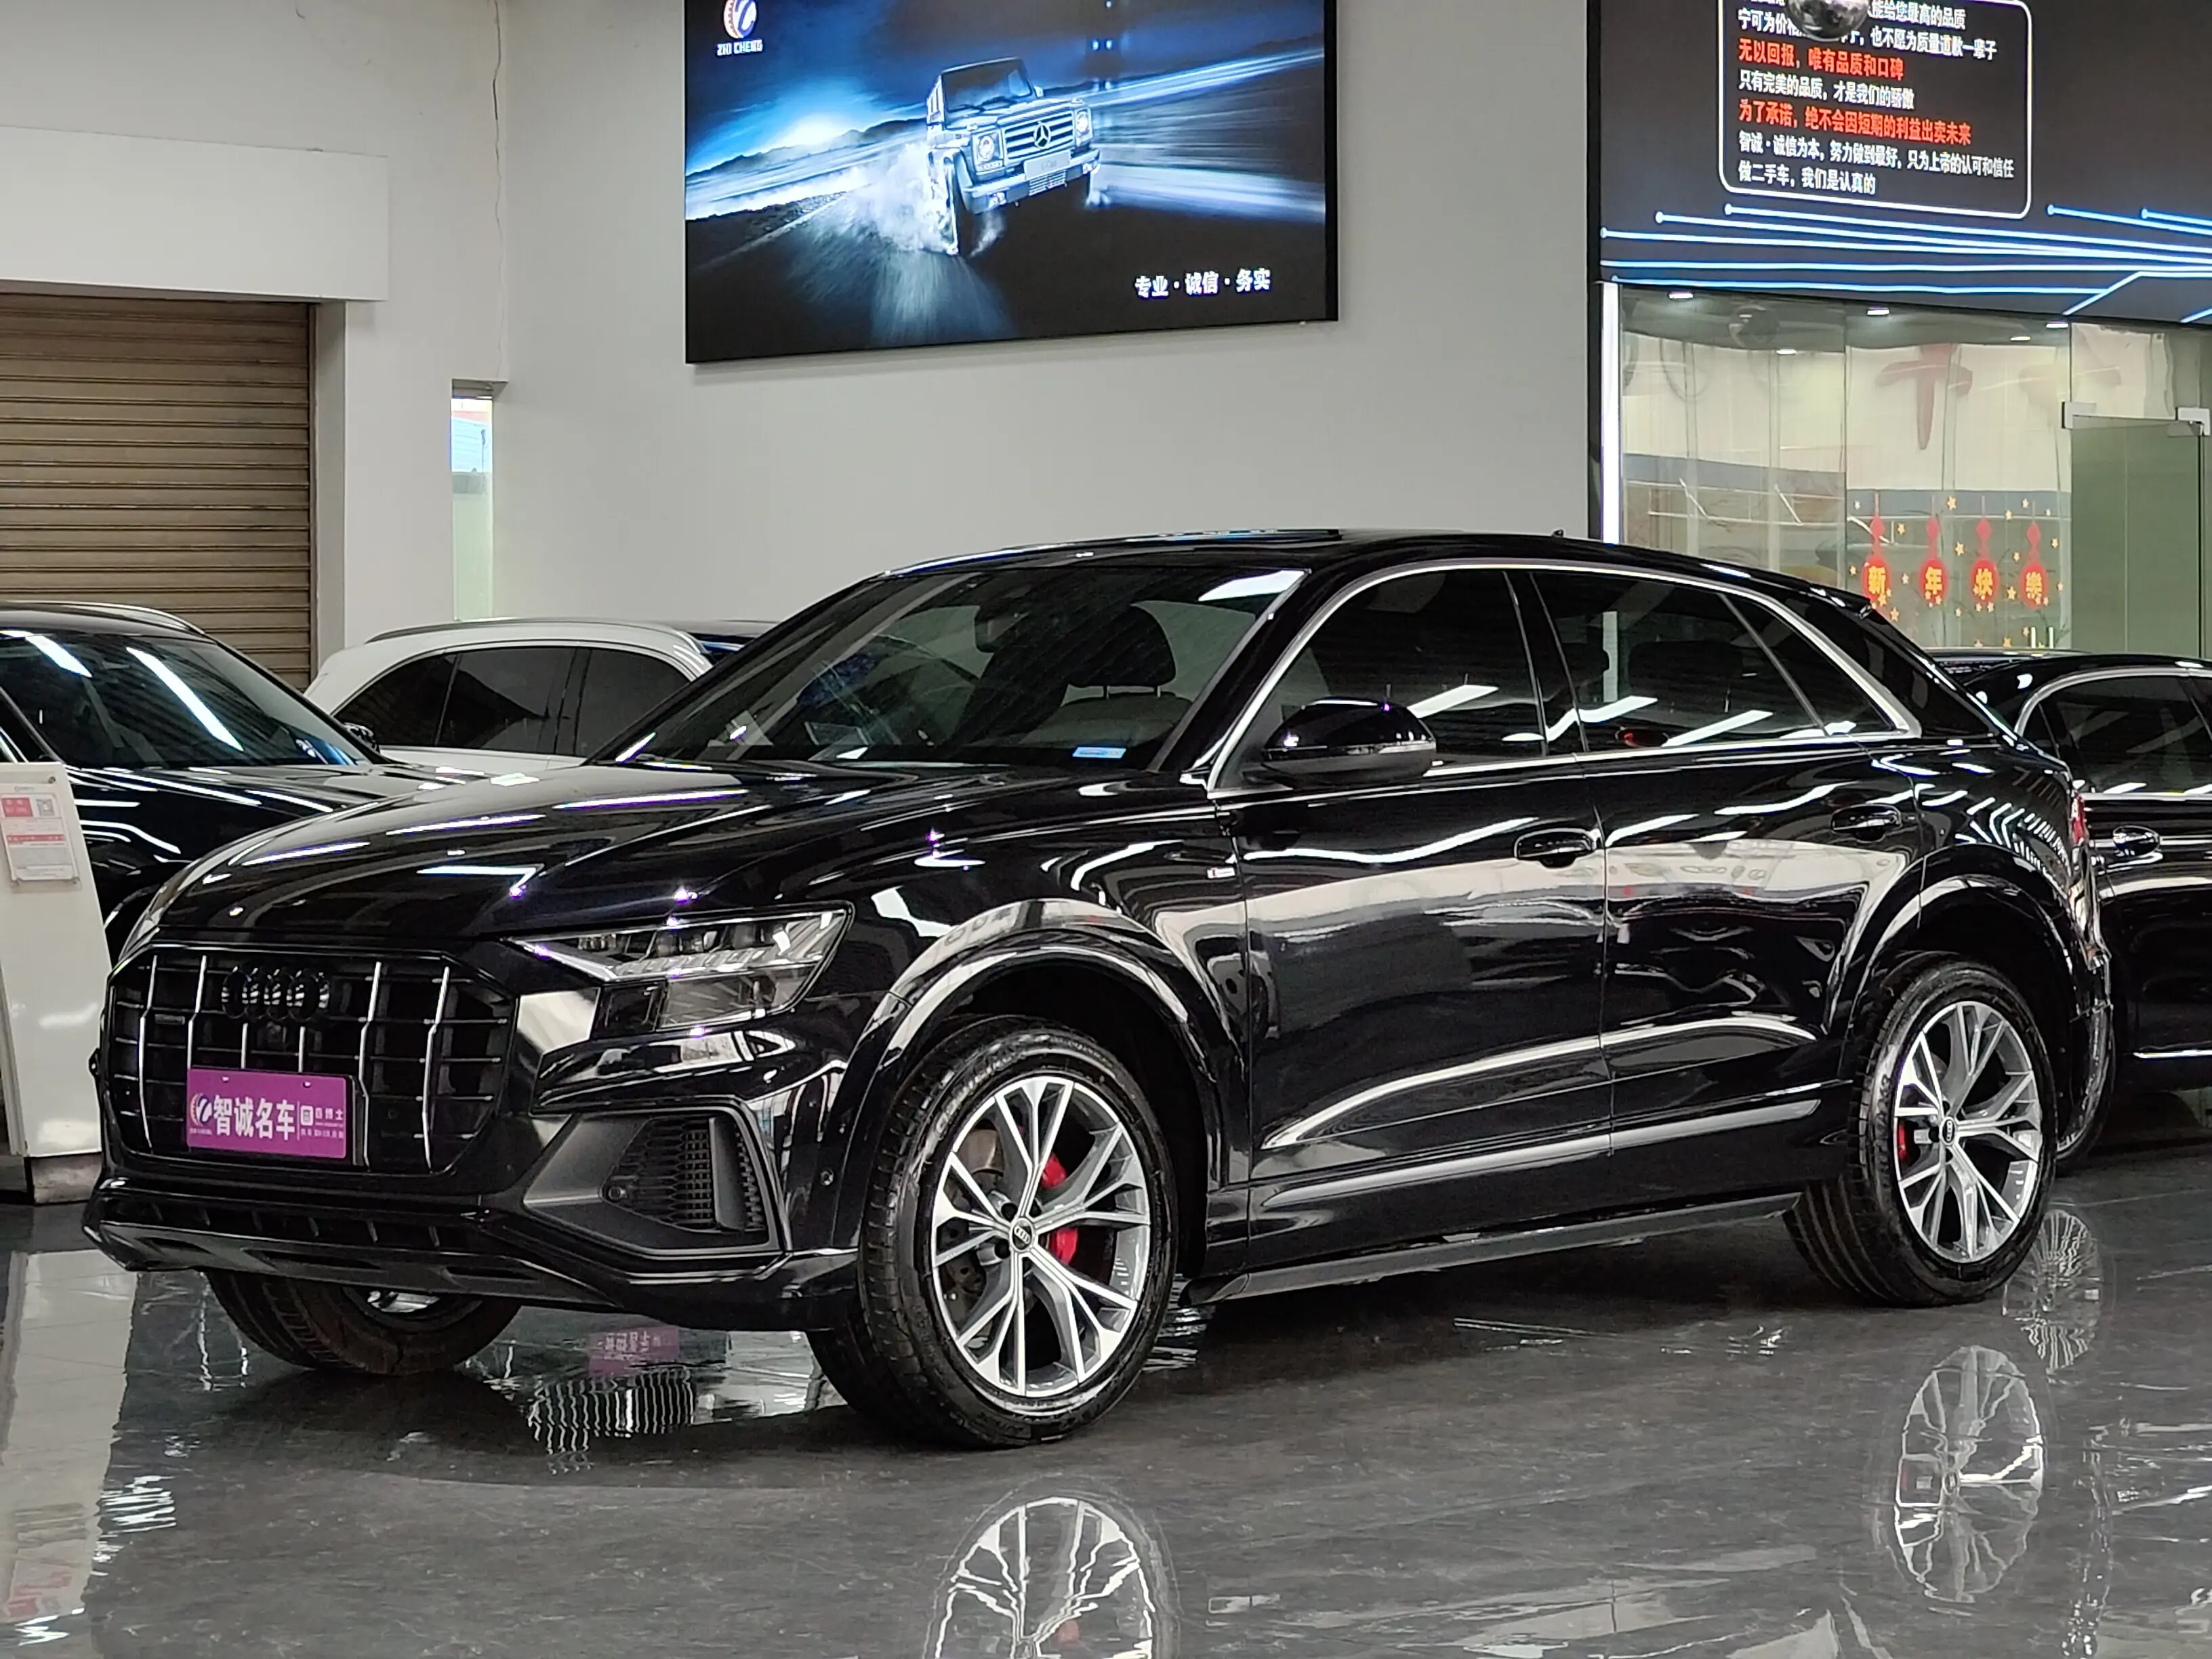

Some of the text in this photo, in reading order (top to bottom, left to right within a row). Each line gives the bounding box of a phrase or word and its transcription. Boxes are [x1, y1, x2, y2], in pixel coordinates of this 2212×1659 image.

[1868, 566, 1885, 594] 新
[1925, 567, 1942, 595] 年
[1975, 568, 1993, 596] 快
[213, 1094, 295, 1141] 智诚名车
